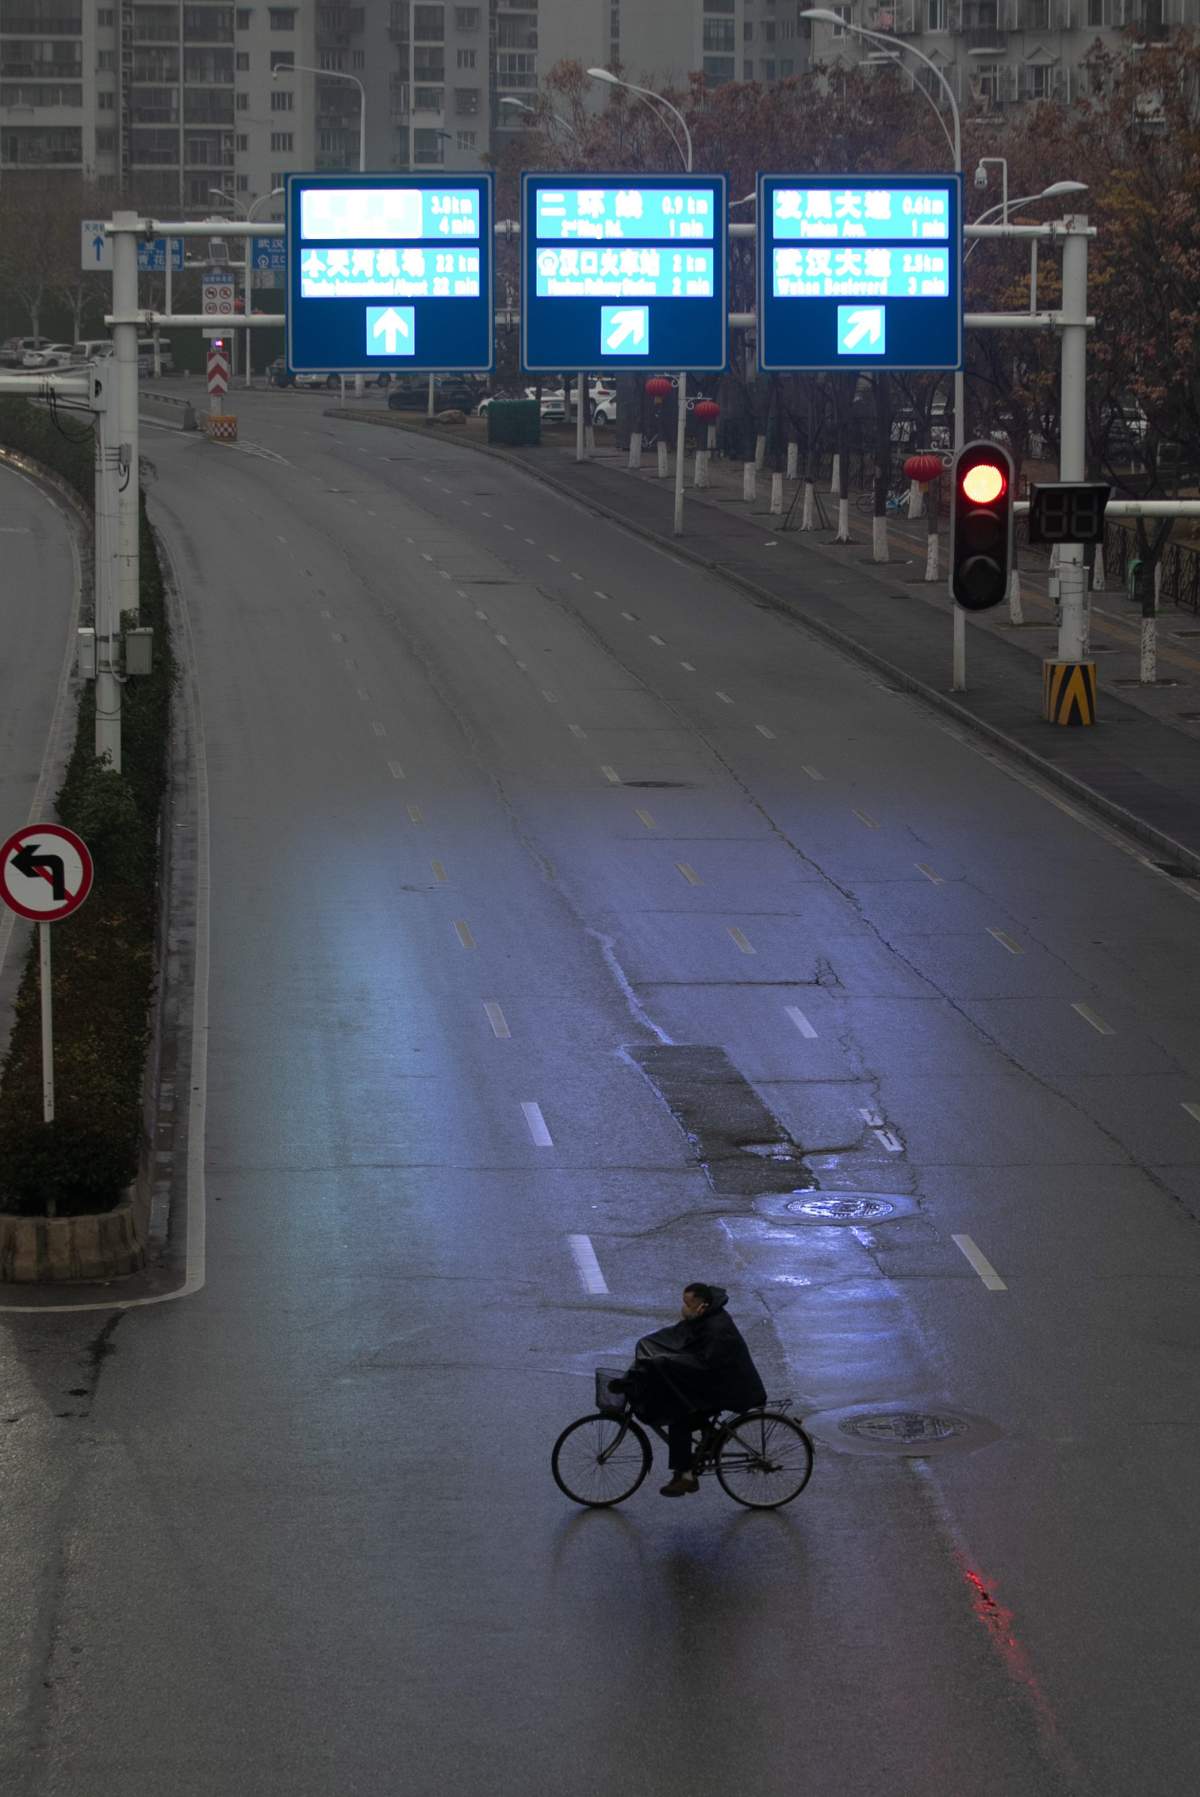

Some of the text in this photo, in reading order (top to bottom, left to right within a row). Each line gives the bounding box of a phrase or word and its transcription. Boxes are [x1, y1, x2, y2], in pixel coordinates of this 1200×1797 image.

[687, 196, 708, 215] km
[776, 190, 891, 220] 发展大道
[439, 215, 475, 235] 4 min
[669, 218, 704, 238] 1 min
[911, 219, 945, 238] 1 min
[687, 254, 707, 272] km
[776, 248, 891, 277] 武汉大道
[455, 277, 479, 296] min
[687, 277, 710, 296] min
[778, 278, 820, 295] Wuhan
[922, 277, 945, 296] min
